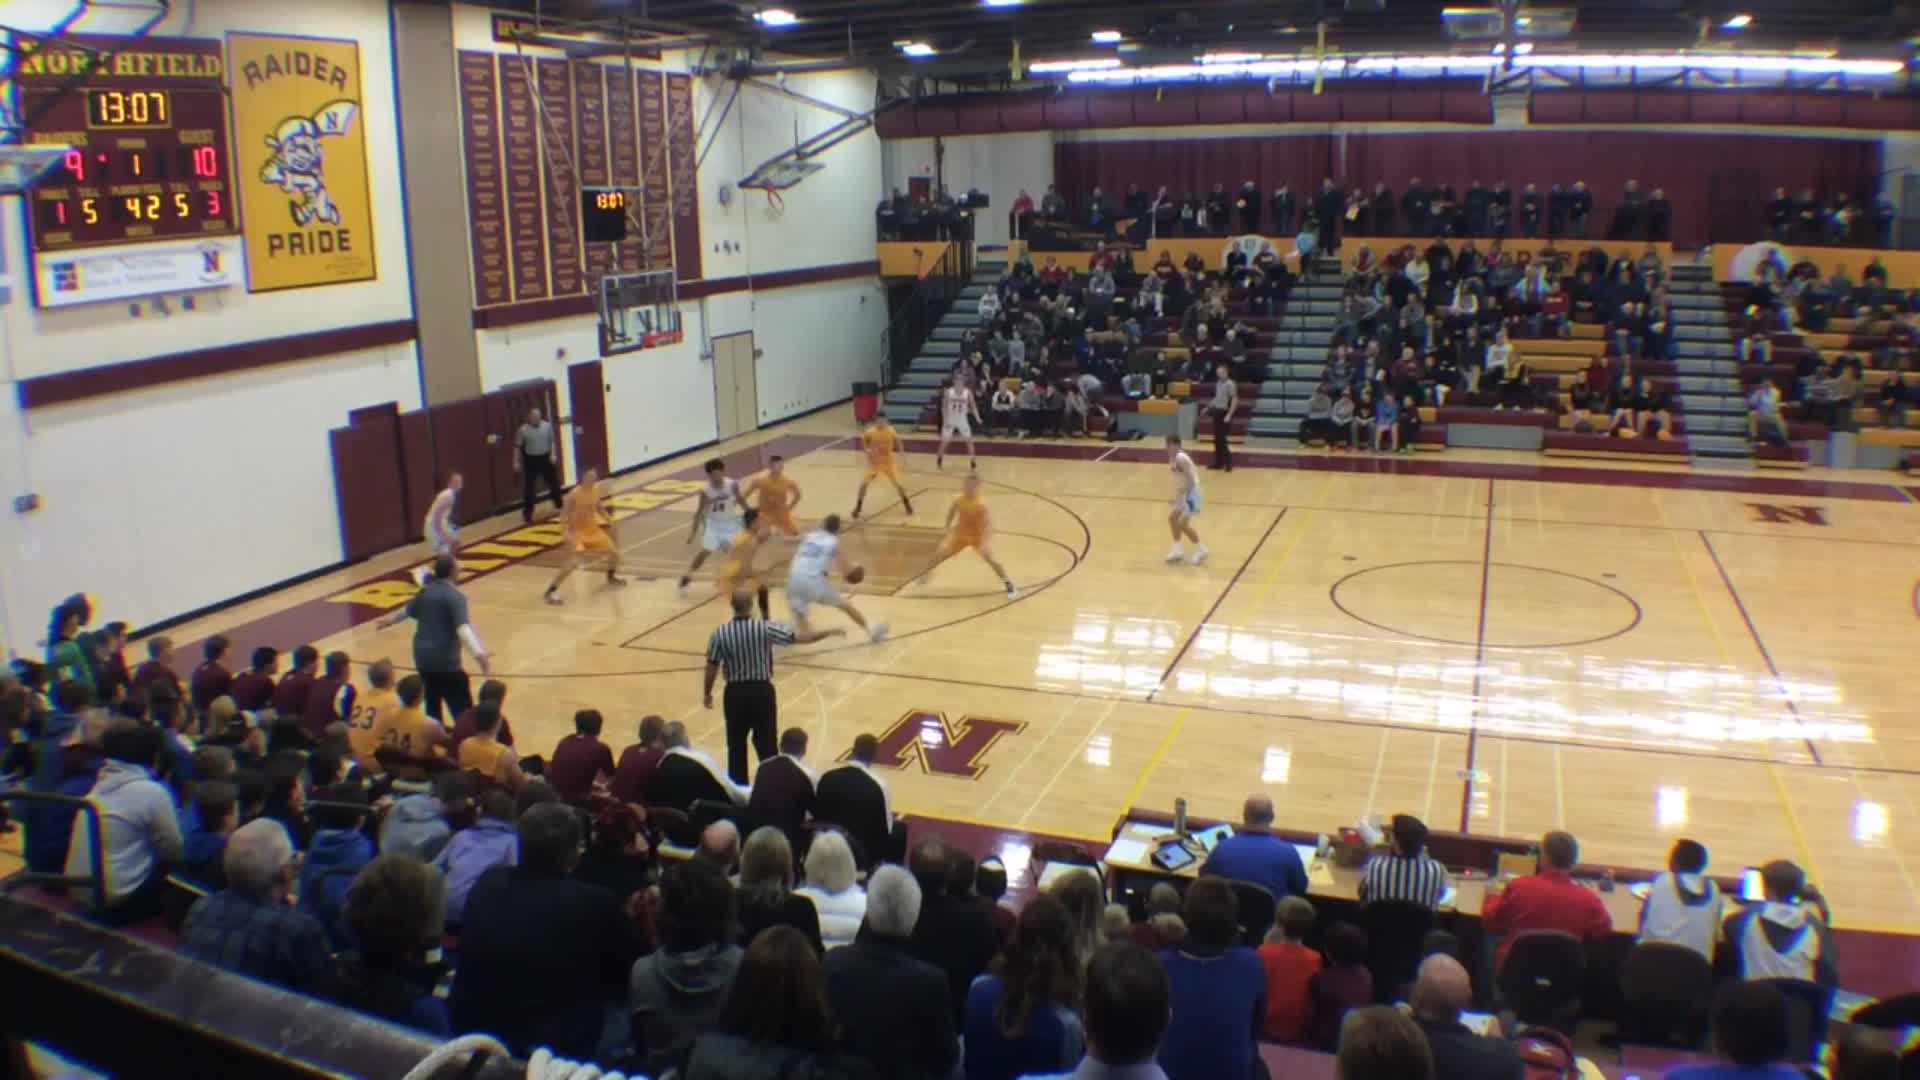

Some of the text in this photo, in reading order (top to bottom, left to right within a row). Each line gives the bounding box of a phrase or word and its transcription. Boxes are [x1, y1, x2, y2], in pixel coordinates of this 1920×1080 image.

[243, 51, 348, 92] RAIDER
[101, 91, 165, 122] 13:07
[65, 151, 84, 181] 9
[192, 146, 217, 177] 10
[82, 199, 98, 225] 5
[174, 192, 190, 218] 5
[207, 190, 221, 215] 3
[268, 230, 352, 259] PRIDE
[1743, 503, 1831, 526] N
[325, 479, 705, 609] RIDRS
[834, 708, 1030, 781] N
